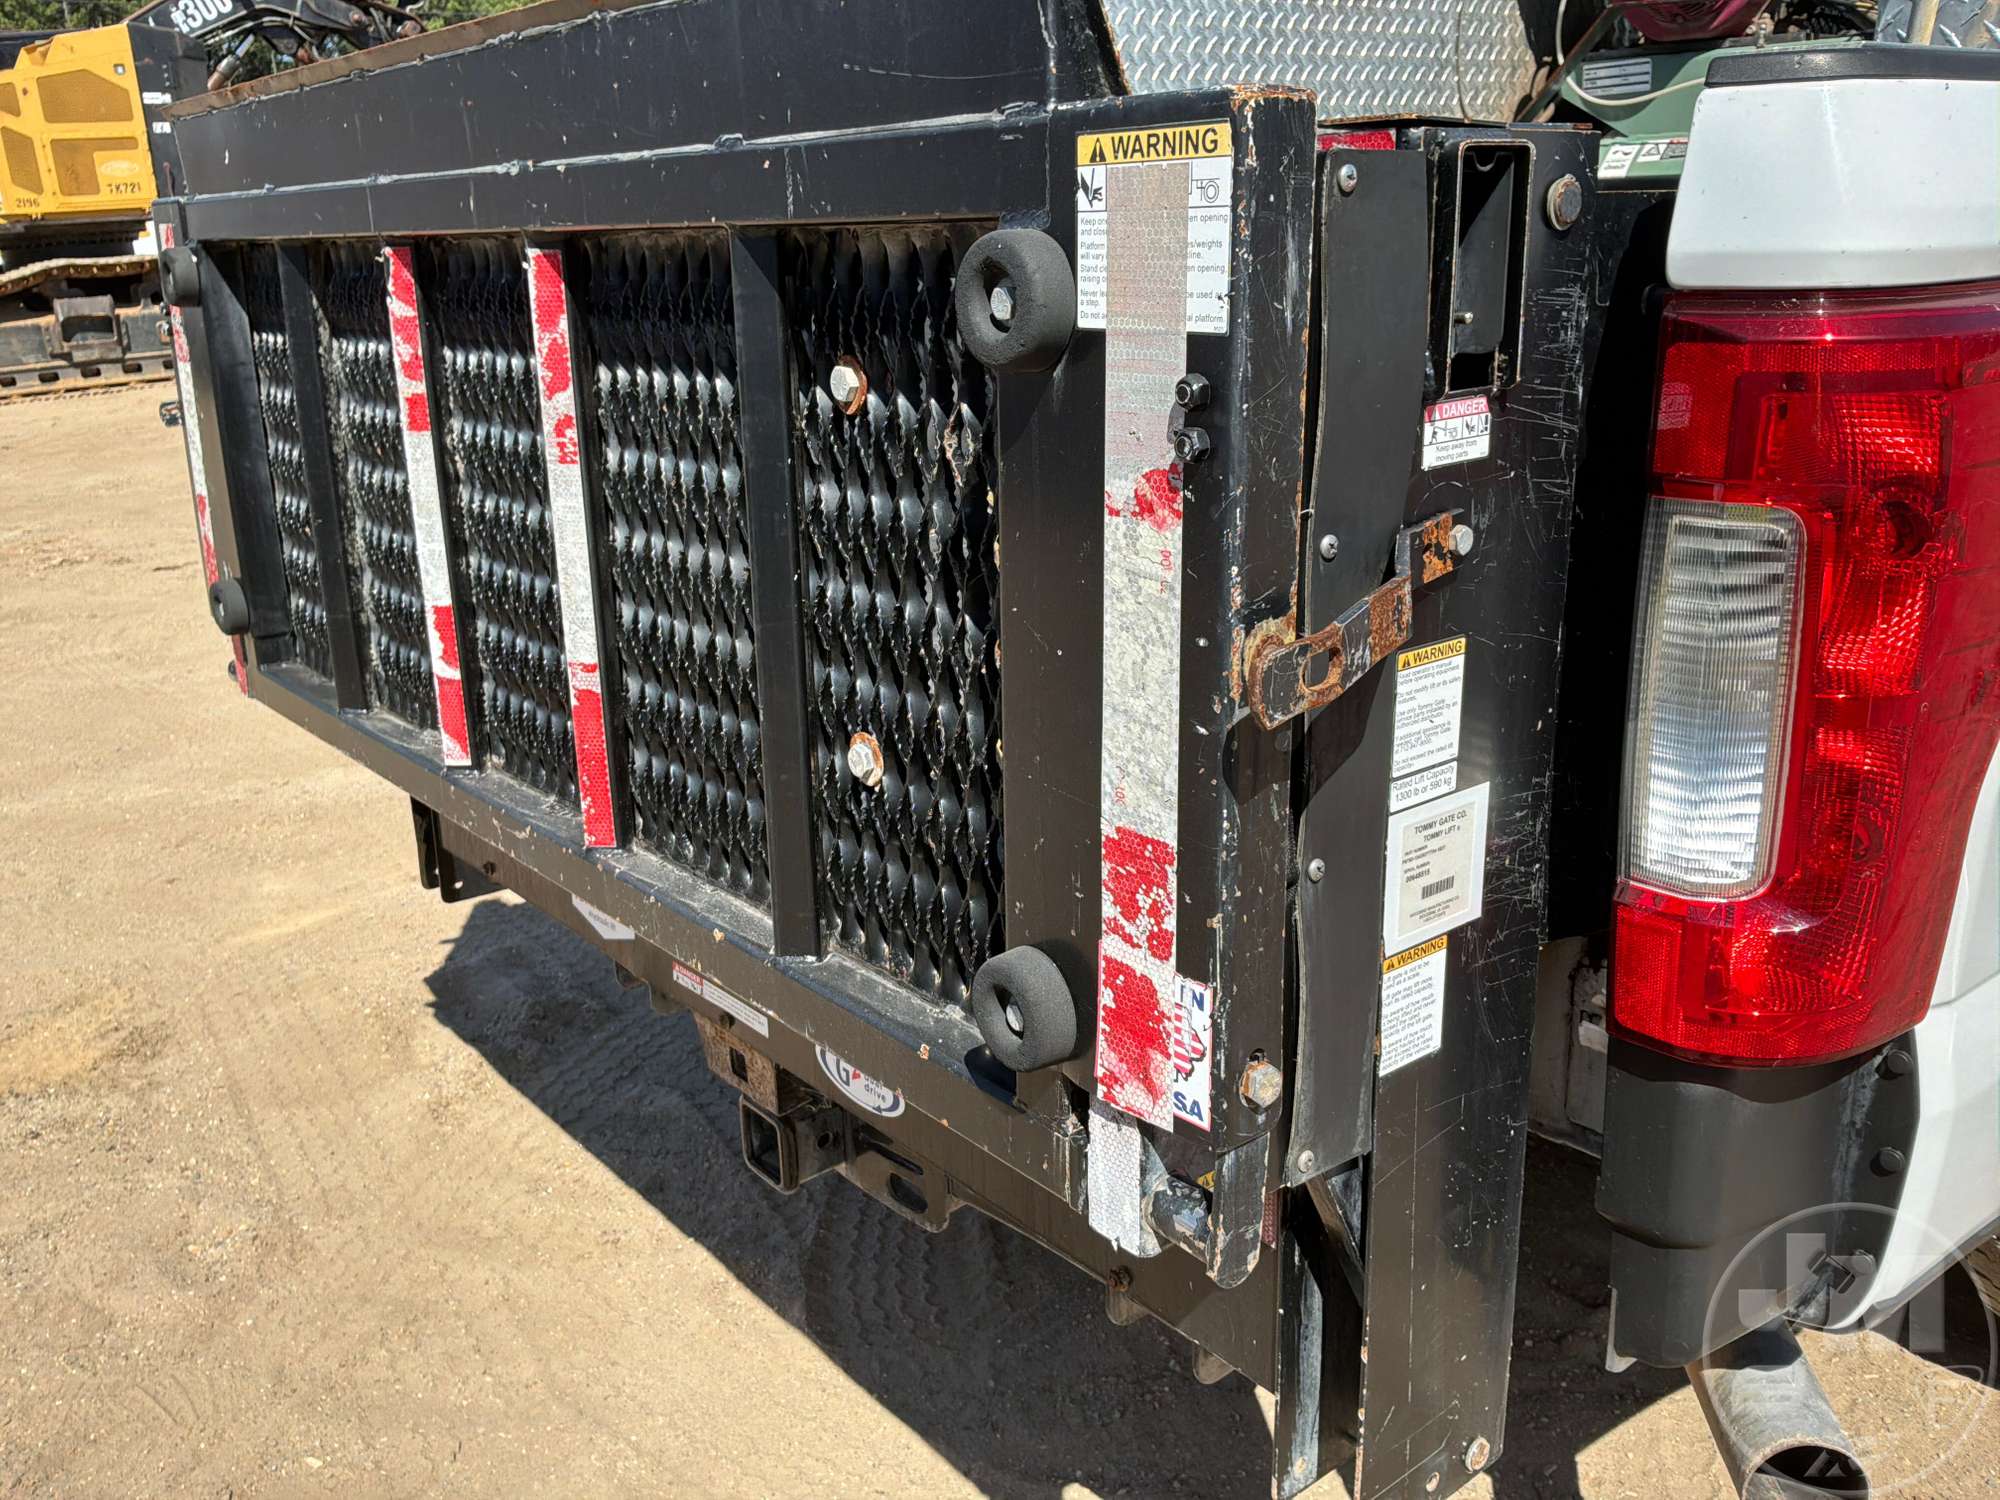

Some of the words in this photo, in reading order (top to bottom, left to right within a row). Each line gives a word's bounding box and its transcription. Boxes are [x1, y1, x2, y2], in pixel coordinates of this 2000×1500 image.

[1111, 127, 1218, 160] WARNING
[1080, 217, 1096, 227] Keep
[1080, 241, 1105, 250] Platform
[1080, 264, 1098, 273] Stand
[1442, 400, 1486, 418] DANGER
[1413, 640, 1462, 665] WARNING
[1414, 819, 1438, 835] TOMMY
[1438, 813, 1456, 826] GATE
[1423, 829, 1444, 842] TOMMY
[1396, 937, 1445, 965] WARNING
